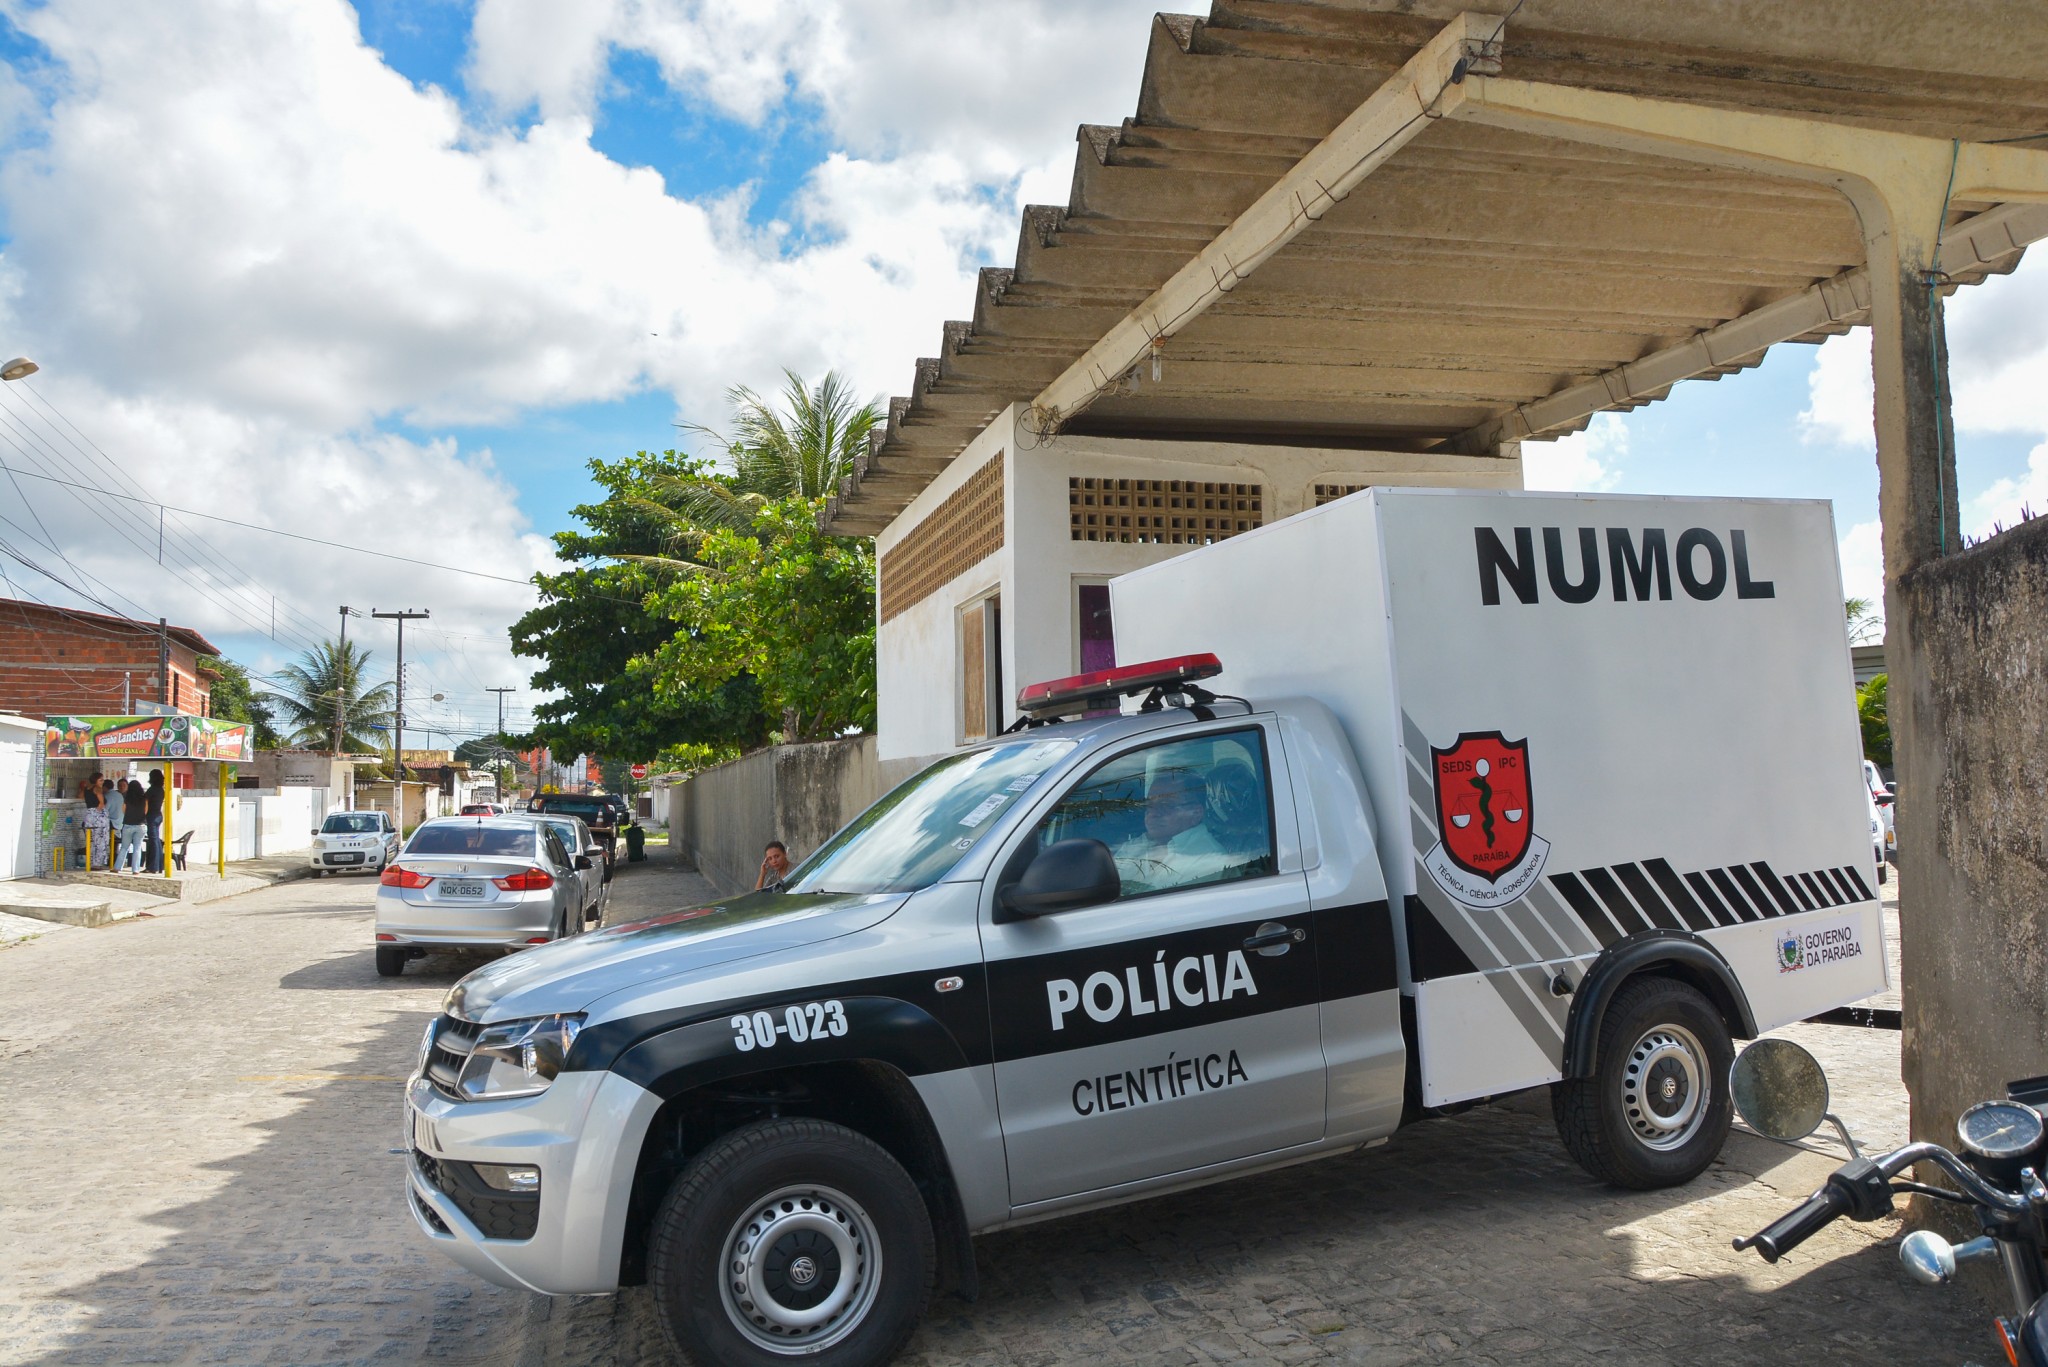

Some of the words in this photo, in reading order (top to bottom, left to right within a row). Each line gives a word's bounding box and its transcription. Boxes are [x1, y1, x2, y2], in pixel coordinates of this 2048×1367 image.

[1474, 526, 1775, 606] NUMOL
[117, 728, 155, 744] Lanches
[1442, 760, 1472, 773] SEDS
[1498, 757, 1517, 769] IPC
[1473, 850, 1510, 863] PARAÍBA
[1438, 863, 1464, 894] TÉCNICA
[1503, 853, 1541, 896] CONSCIÊNCIA
[1805, 926, 1852, 950] GOVERNO
[1806, 951, 1821, 967] DA
[1822, 941, 1862, 964] PARAÍBA
[1046, 949, 1258, 1031] POLÍCIA
[730, 1000, 849, 1052] 30-023
[1072, 1049, 1249, 1116] CIENTÍFICA
